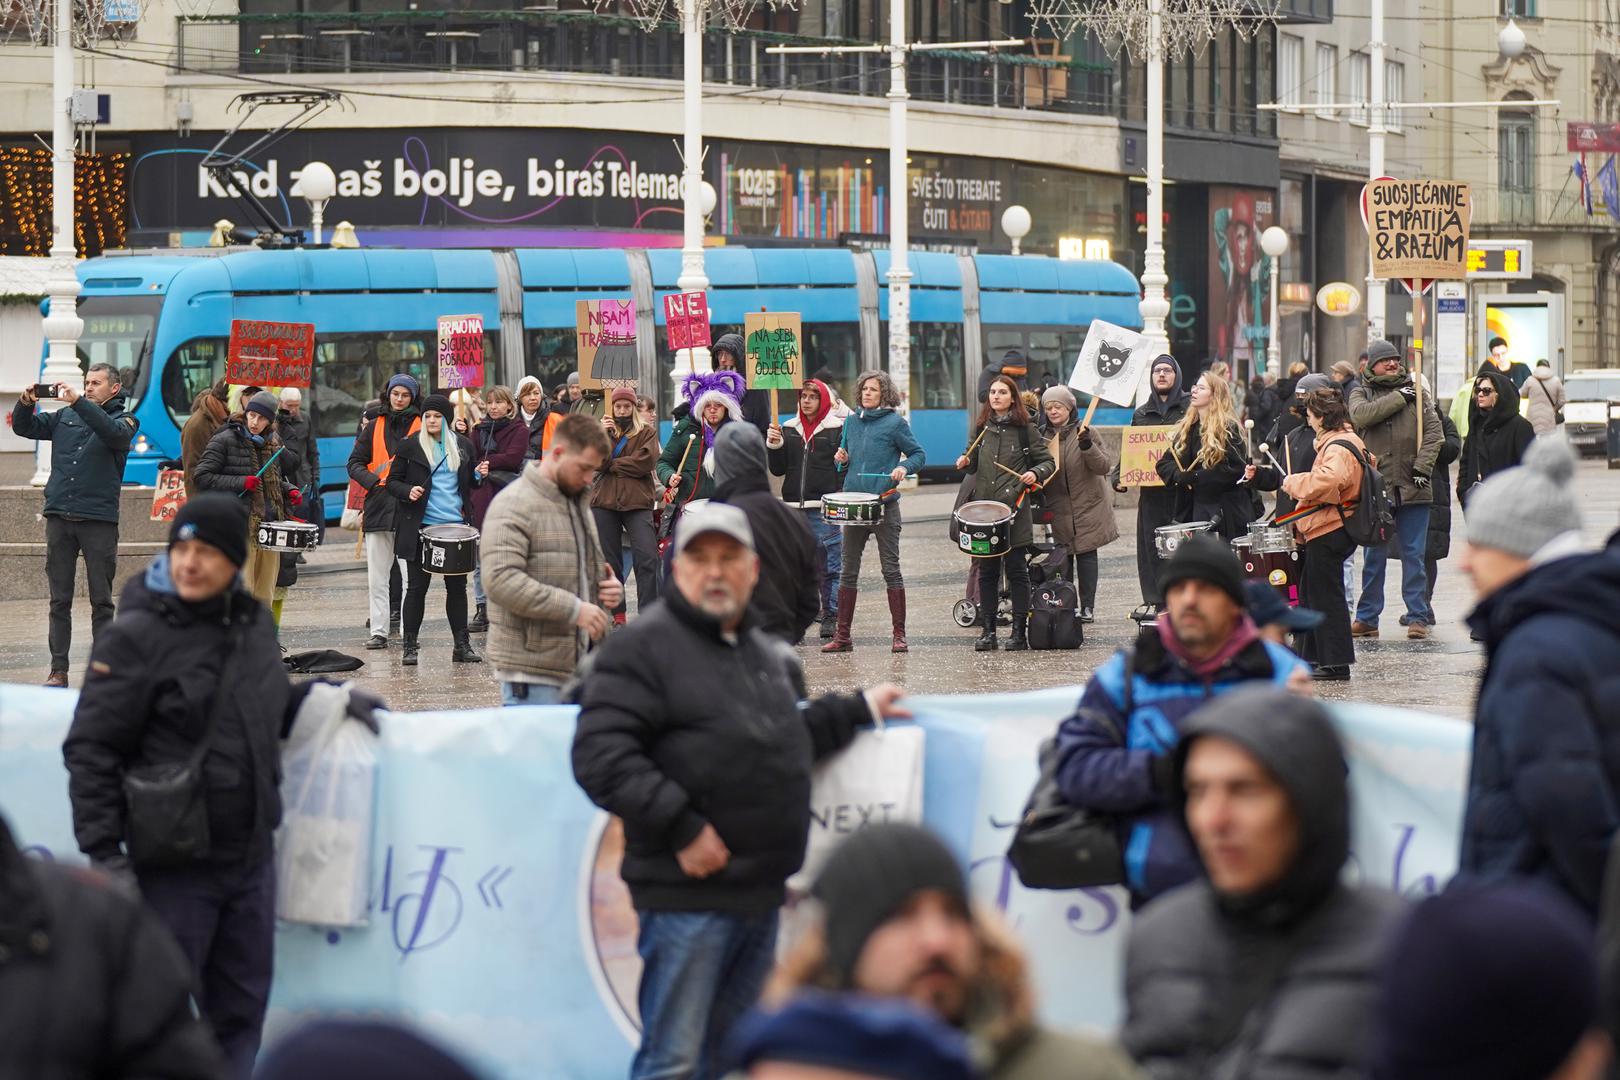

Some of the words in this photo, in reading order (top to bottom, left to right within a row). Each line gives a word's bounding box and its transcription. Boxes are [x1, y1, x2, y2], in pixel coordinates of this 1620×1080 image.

[289, 160, 383, 197] zaš
[394, 158, 516, 207] bolje,
[528, 158, 605, 198] biraš
[912, 177, 933, 198] SVE
[934, 171, 954, 199] ŠTO
[956, 180, 1001, 201] TREBATE
[1373, 181, 1467, 214] SUOSJEĆANJE
[923, 202, 948, 230] ČUTI
[949, 210, 958, 231] &
[589, 309, 631, 326] NISAM
[668, 293, 703, 318] NE
[440, 336, 483, 352] SIGURAN
[755, 329, 770, 343] NA
[773, 328, 793, 343] SEBI
[749, 346, 761, 360] JE
[809, 802, 895, 833] NEXT
